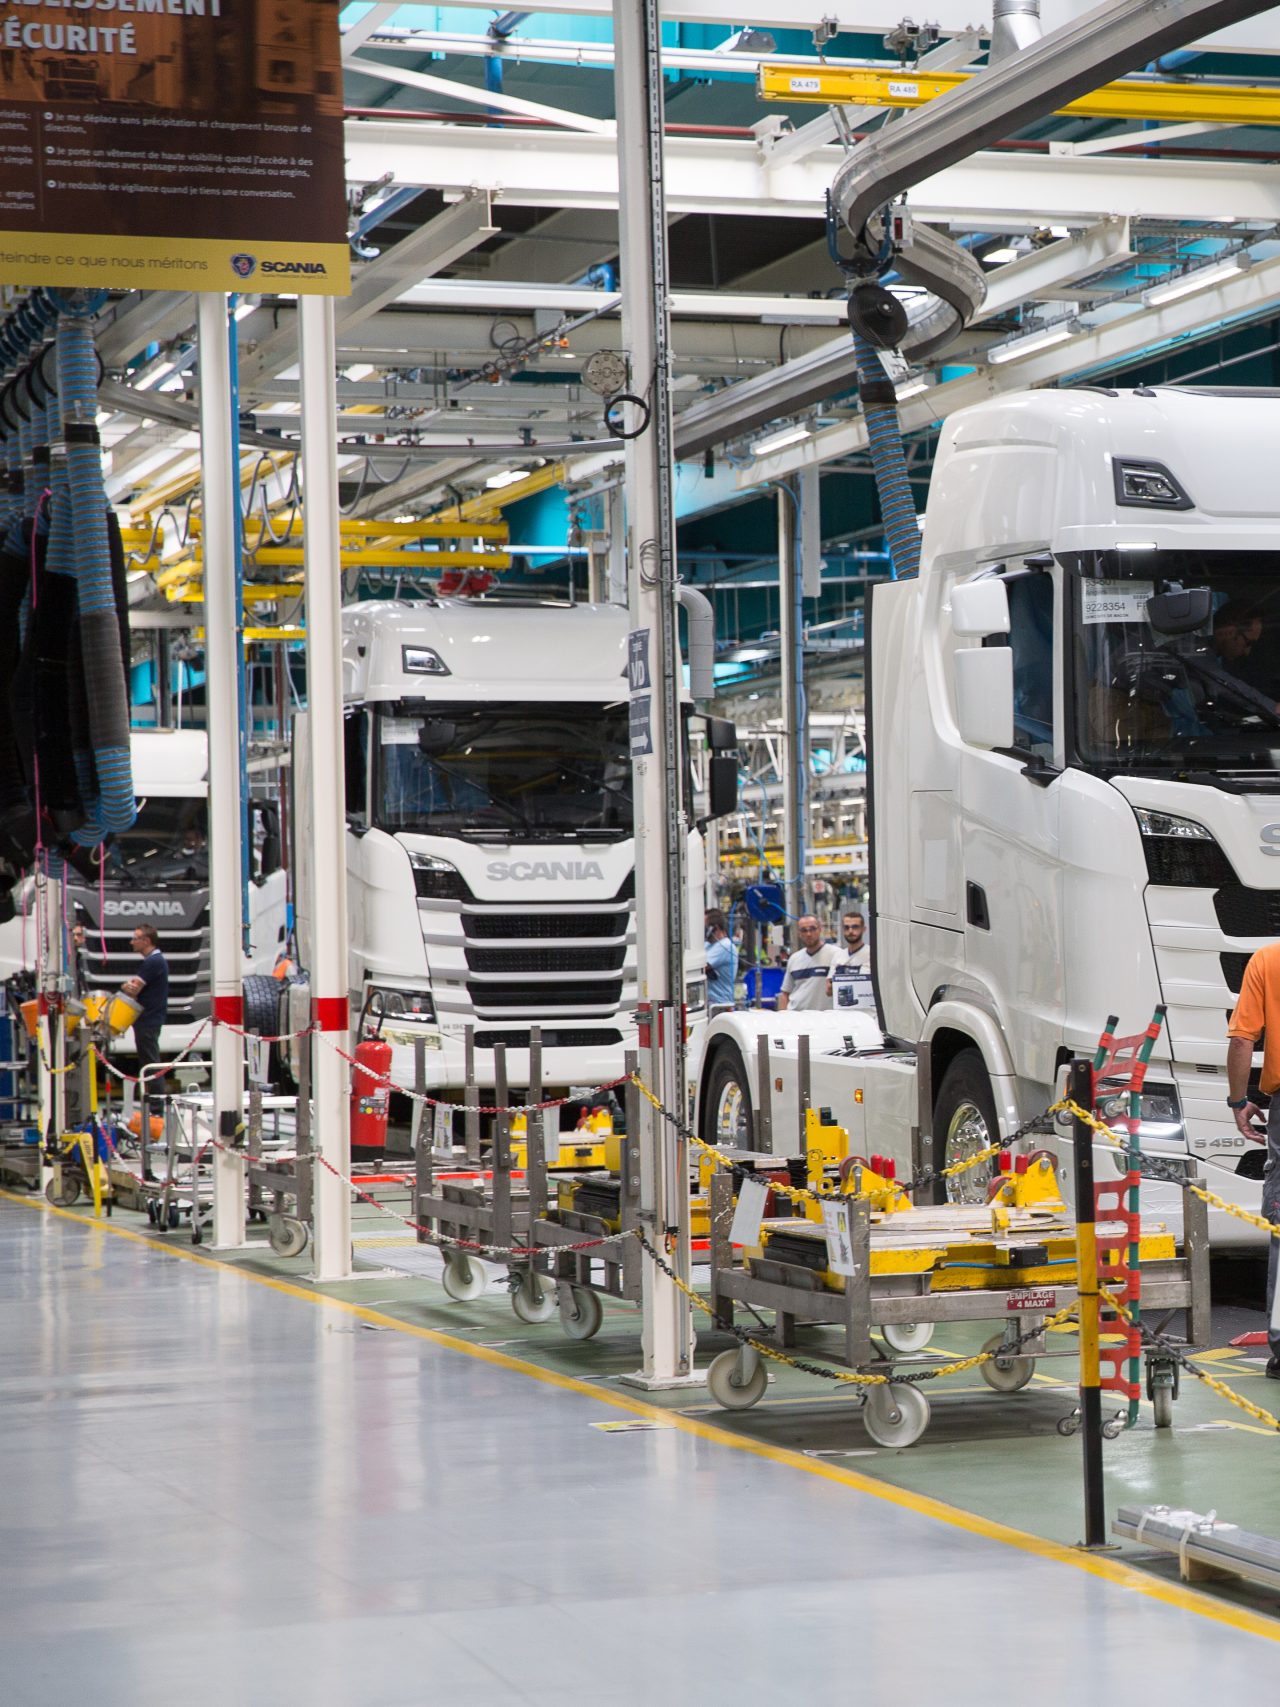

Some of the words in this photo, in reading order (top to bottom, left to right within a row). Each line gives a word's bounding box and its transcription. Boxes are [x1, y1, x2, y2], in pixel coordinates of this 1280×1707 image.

[0, 15, 137, 54] ÉCURITÉ
[120, 116, 140, 125] sans
[210, 120, 262, 131] changement
[264, 123, 298, 133] brusque
[301, 124, 312, 133] de
[225, 154, 252, 164] quand
[298, 157, 313, 166] des
[161, 185, 188, 195] quand
[56, 255, 75, 265] ce
[79, 256, 107, 268] que
[112, 257, 145, 268] nous
[149, 257, 208, 270] méritons
[260, 261, 327, 274] SCANIA
[486, 861, 604, 882] SCANIA
[103, 900, 186, 916] SCANIA
[1194, 1137, 1207, 1148] S
[1209, 1137, 1245, 1147] 450
[1009, 1291, 1055, 1300] EMPILAGE
